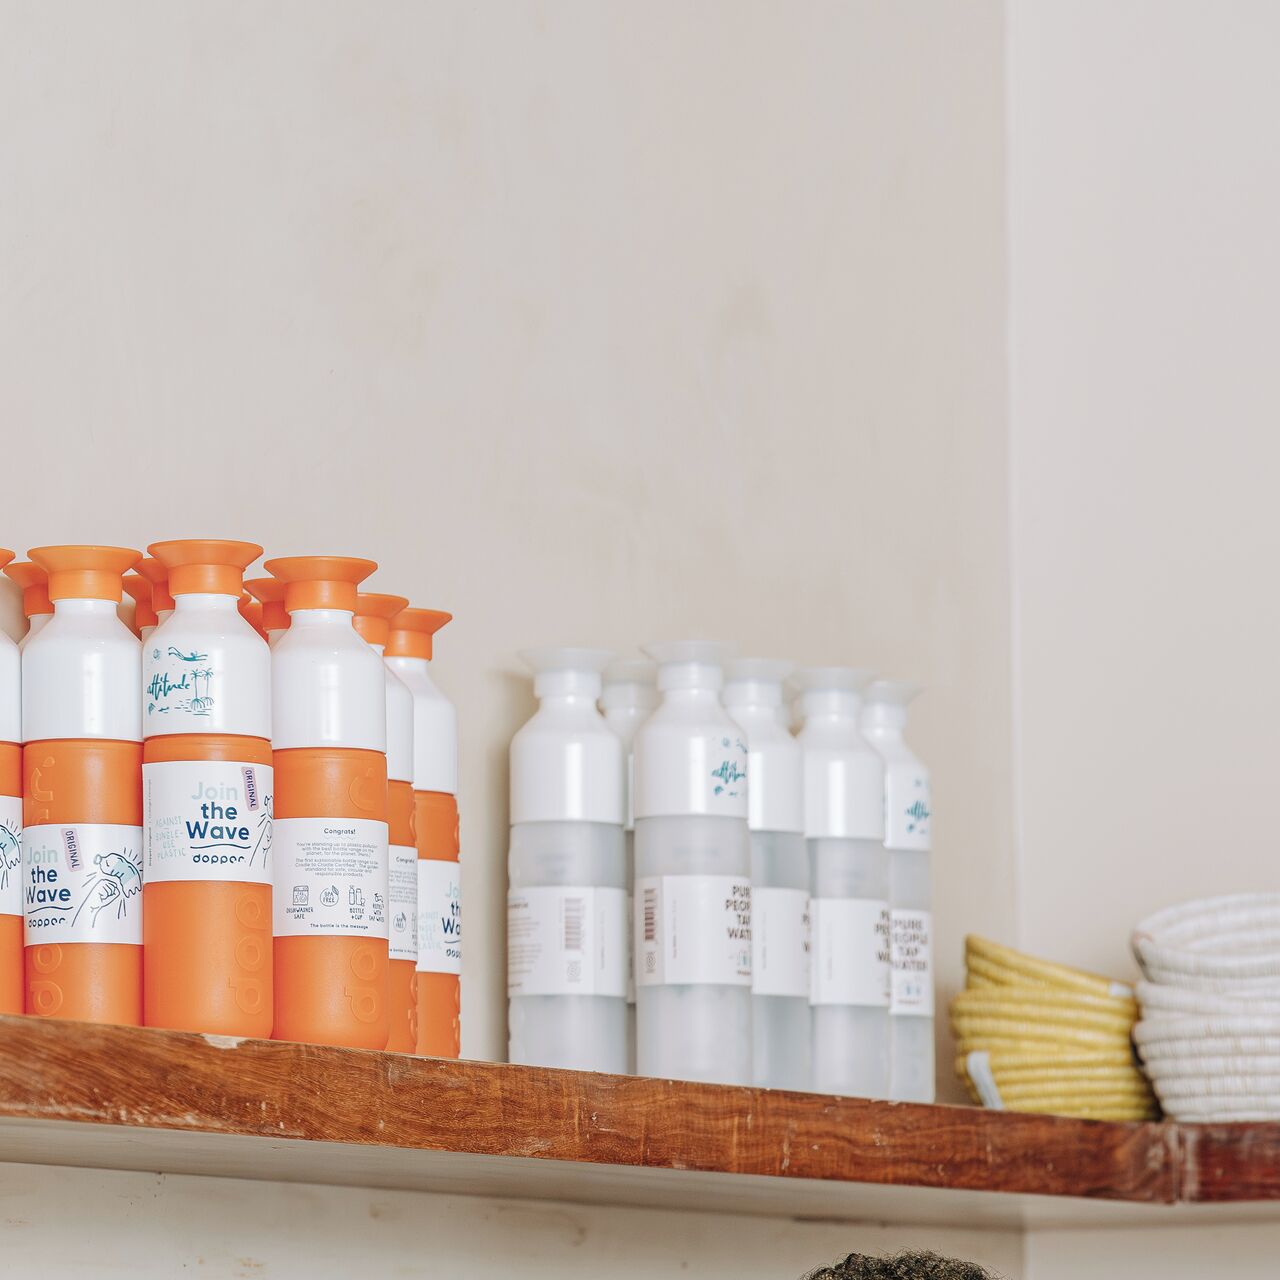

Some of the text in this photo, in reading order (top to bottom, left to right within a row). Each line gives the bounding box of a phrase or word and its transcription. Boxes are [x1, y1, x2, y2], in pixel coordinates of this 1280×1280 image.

[147, 672, 190, 701] attitude
[191, 782, 239, 801] Join
[245, 769, 257, 808] ORIGINAL
[201, 801, 238, 820] the
[185, 821, 250, 840] Wave
[27, 845, 58, 864] Join
[65, 830, 80, 869] ORIGINAL
[192, 854, 245, 864] dopper
[31, 865, 58, 884] the
[26, 886, 71, 904] Wave
[445, 881, 461, 899] Jo
[450, 901, 460, 917] th
[28, 917, 66, 928] dopper
[442, 917, 460, 936] Wa
